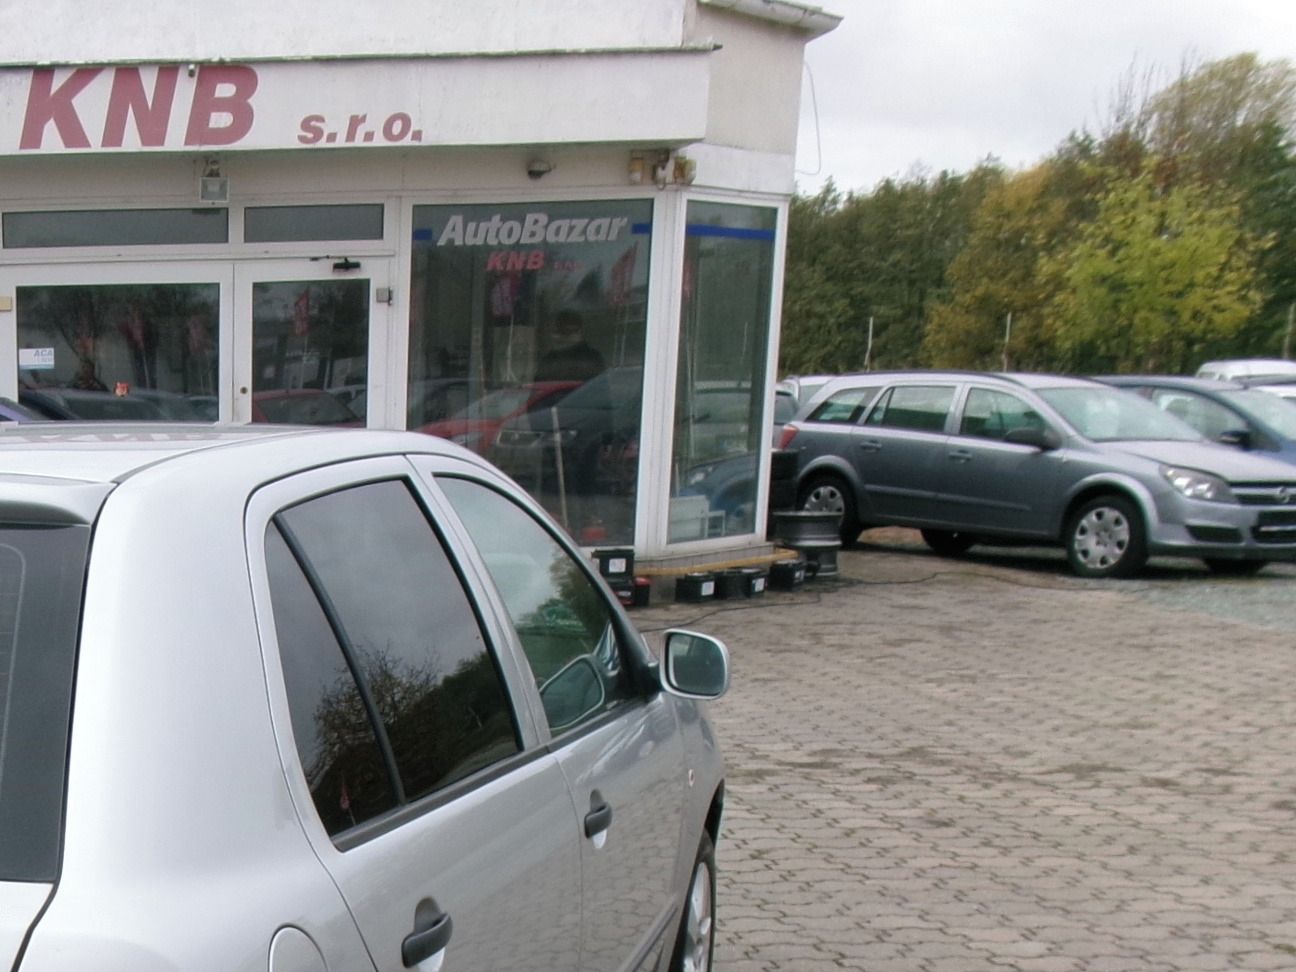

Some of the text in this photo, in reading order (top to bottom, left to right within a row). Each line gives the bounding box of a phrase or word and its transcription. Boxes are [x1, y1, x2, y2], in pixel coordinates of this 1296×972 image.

[19, 65, 423, 150] KNB s.r.o.
[436, 212, 629, 246] AutoBazar
[486, 250, 545, 271] KNB
